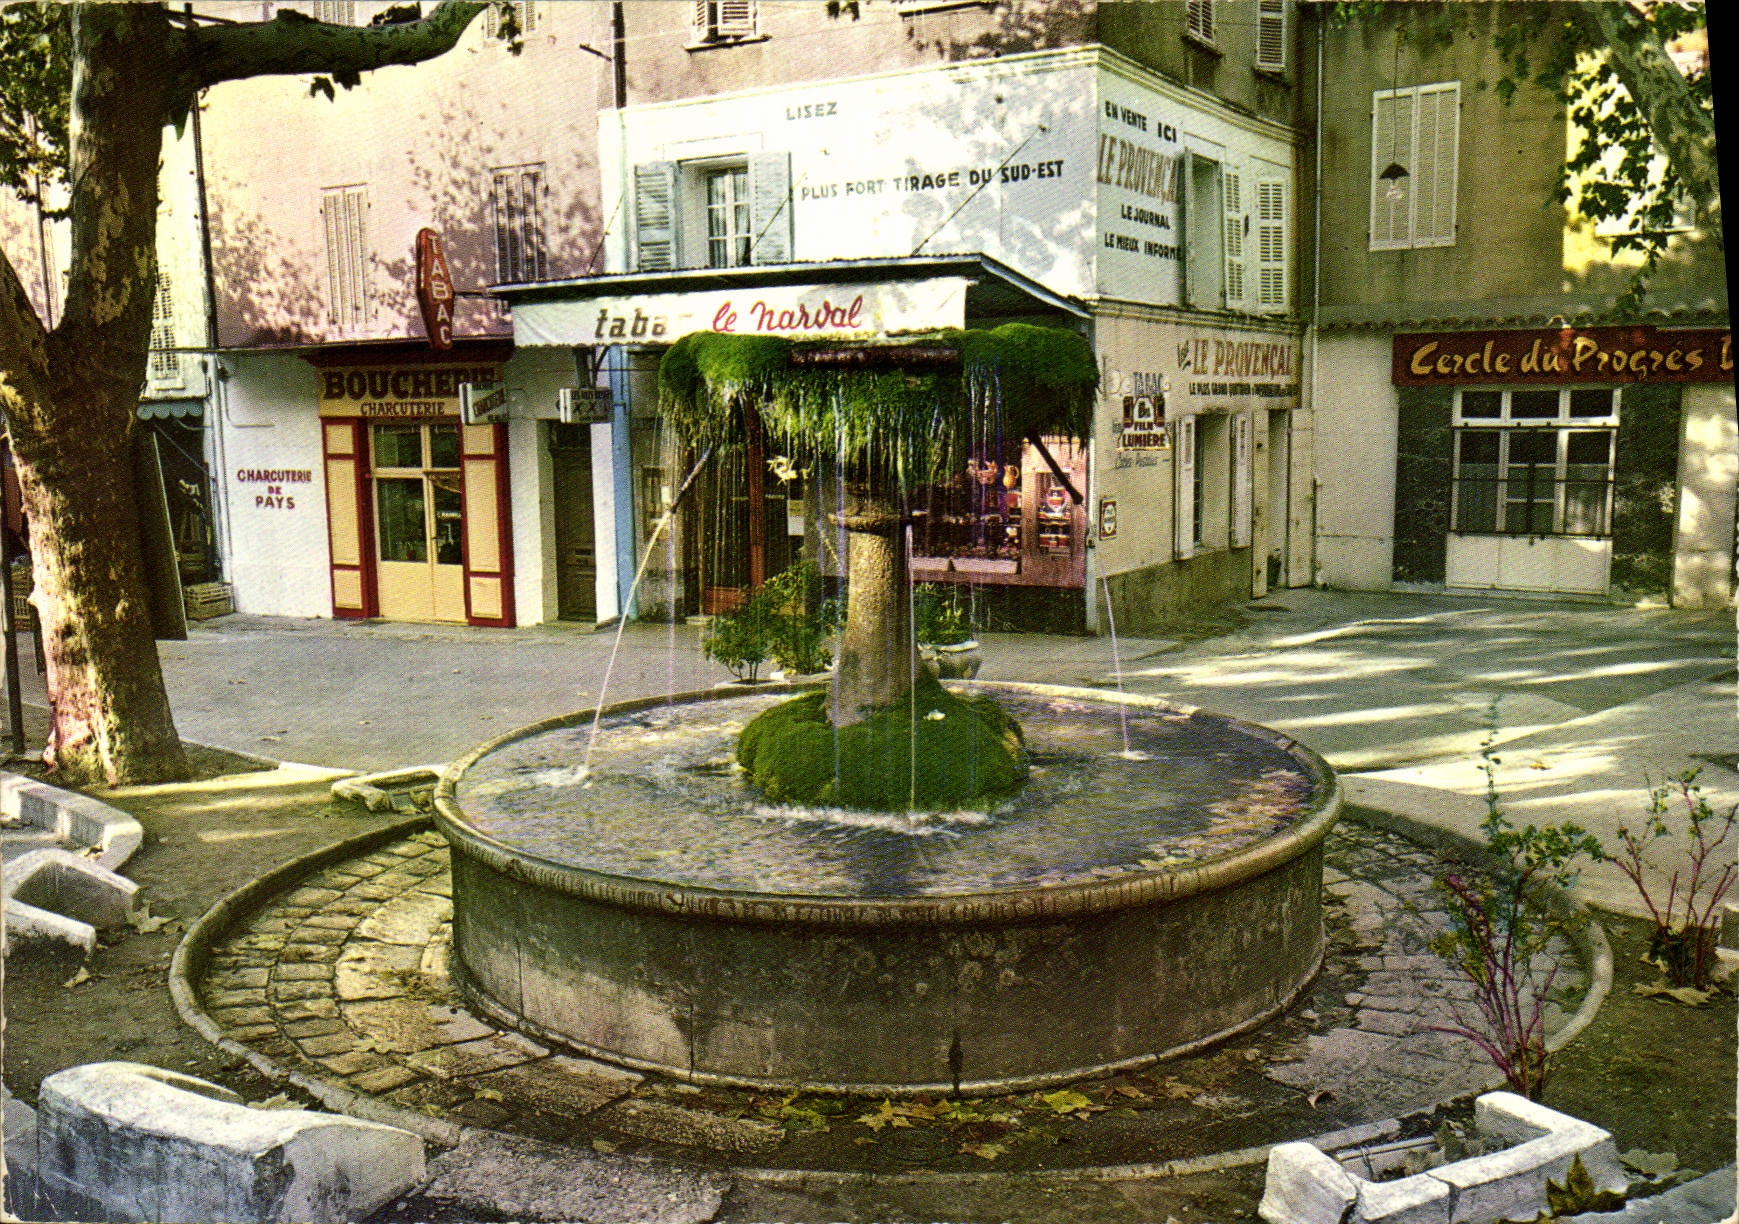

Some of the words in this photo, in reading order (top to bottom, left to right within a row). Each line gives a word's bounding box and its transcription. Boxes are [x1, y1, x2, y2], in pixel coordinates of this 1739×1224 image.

[786, 102, 838, 121] LISEZ
[1105, 100, 1119, 120] EN
[1120, 106, 1148, 131] VENTE
[1157, 122, 1177, 143] ICI
[801, 183, 839, 201] PLUS
[846, 180, 884, 195] FORT
[893, 172, 960, 193] TIRAGE
[969, 168, 993, 186] DU
[1000, 160, 1064, 183] SUD-EST
[1115, 138, 1180, 205] PROVENÇA
[1121, 203, 1132, 220] LE
[1133, 207, 1171, 230] JOURNAL
[1104, 232, 1115, 248] LE
[1116, 234, 1140, 253] MIEUX
[427, 234, 452, 345] TABAC
[594, 306, 692, 340] taba
[1192, 337, 1209, 376] LE
[1410, 340, 1511, 375] Cercle
[1520, 338, 1562, 373] du
[360, 401, 446, 417] CHARCUTERIE
[237, 469, 313, 483] CHARCUTERIE
[267, 485, 282, 495] DE
[255, 495, 296, 510] PAYS
